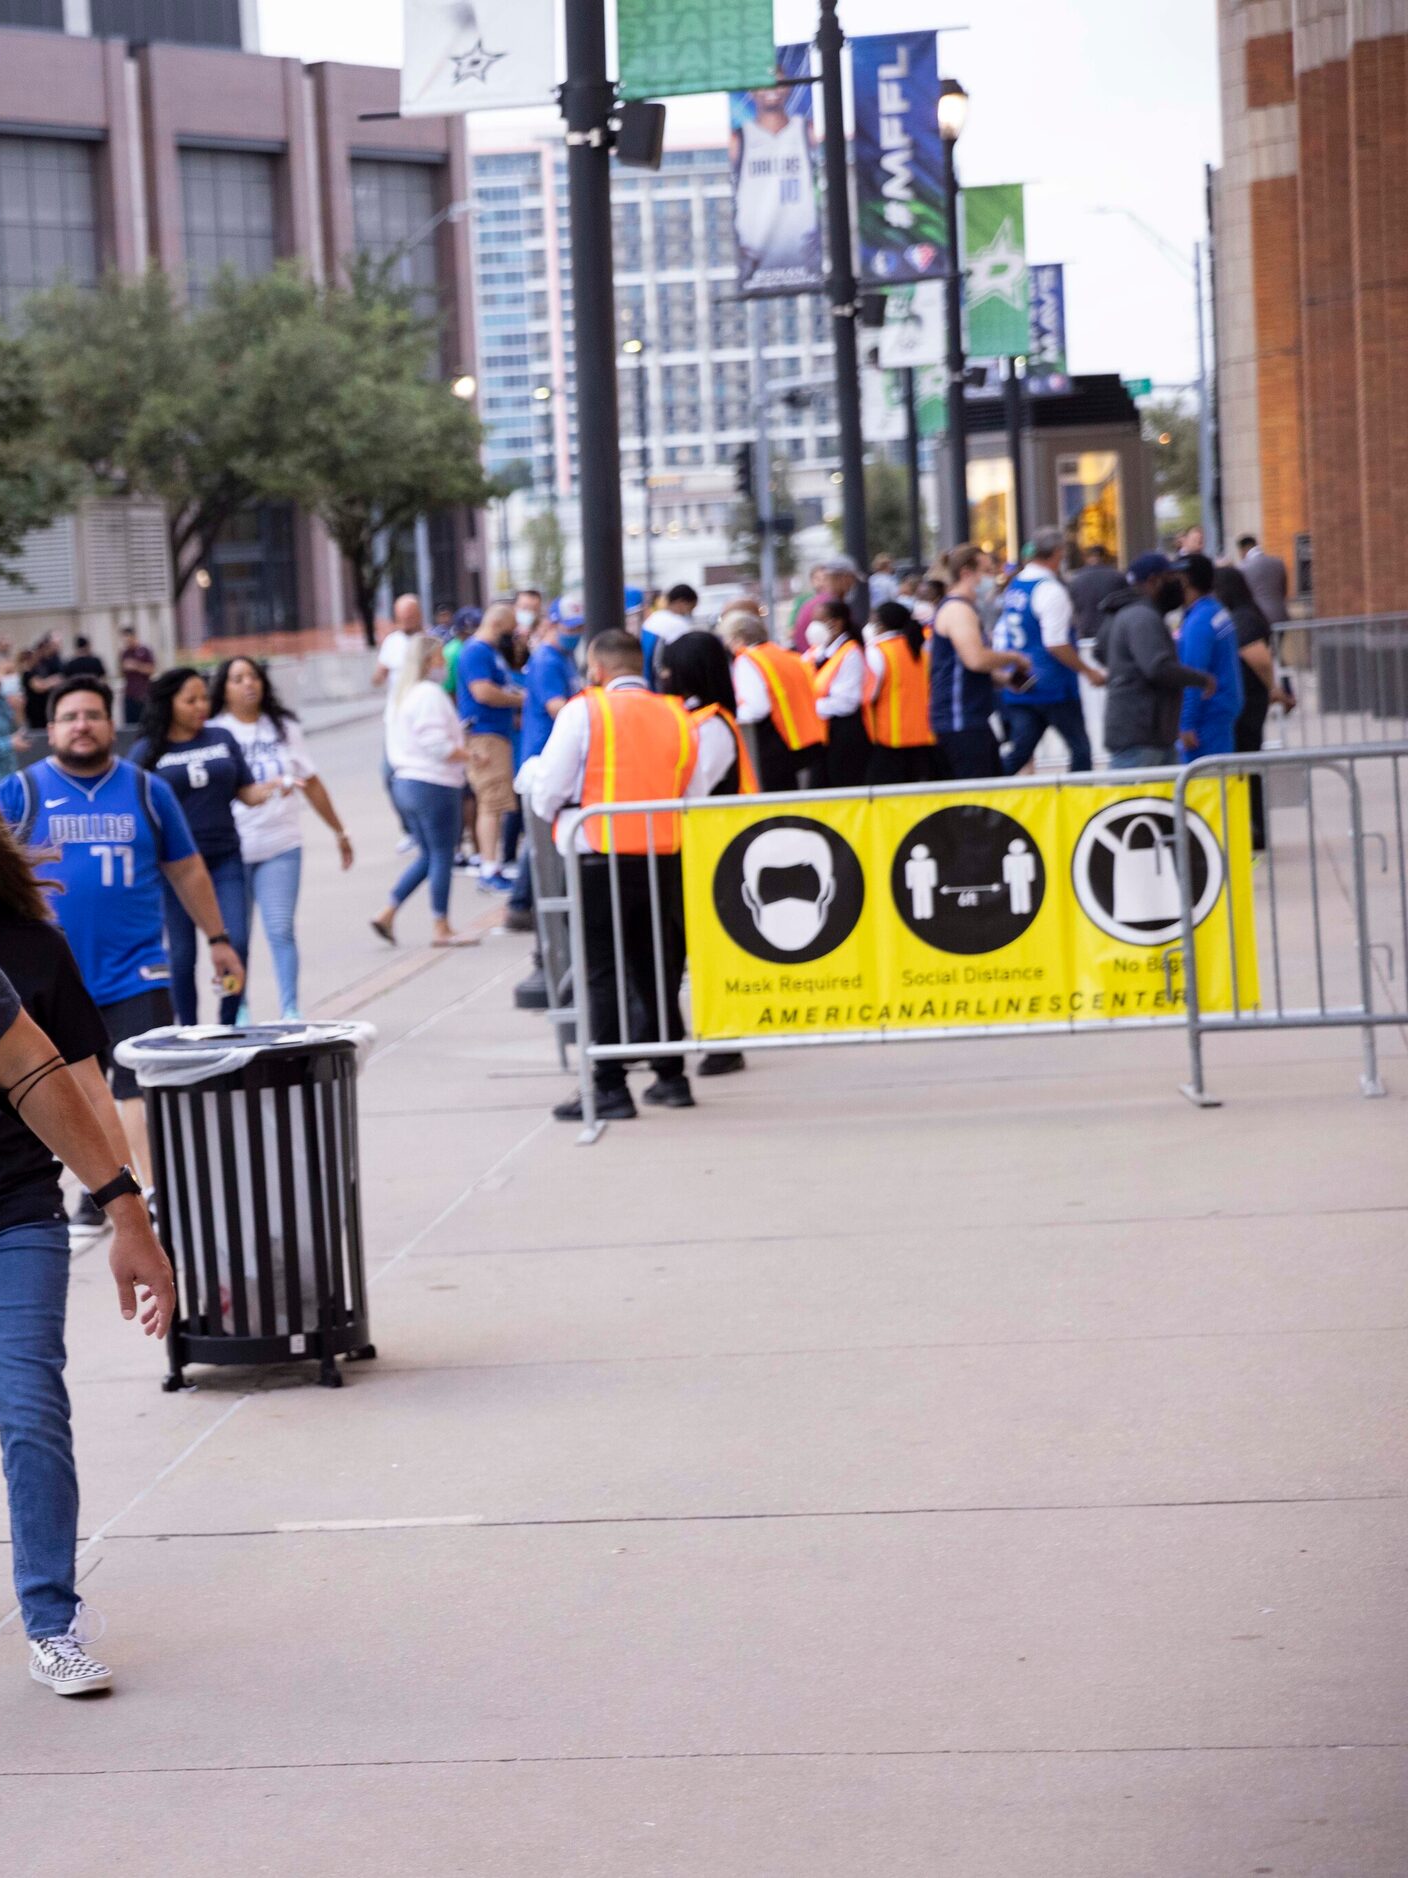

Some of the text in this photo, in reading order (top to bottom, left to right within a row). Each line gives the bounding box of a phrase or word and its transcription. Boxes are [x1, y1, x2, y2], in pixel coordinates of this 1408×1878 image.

[620, 6, 771, 44] STARS
[877, 45, 915, 229] #MFFL
[187, 760, 209, 789] 6
[48, 813, 137, 844] DALLAS
[90, 844, 135, 887] 77
[902, 966, 1044, 987] Social Distance
[1113, 957, 1139, 972] No
[725, 974, 862, 995] Mask Required
